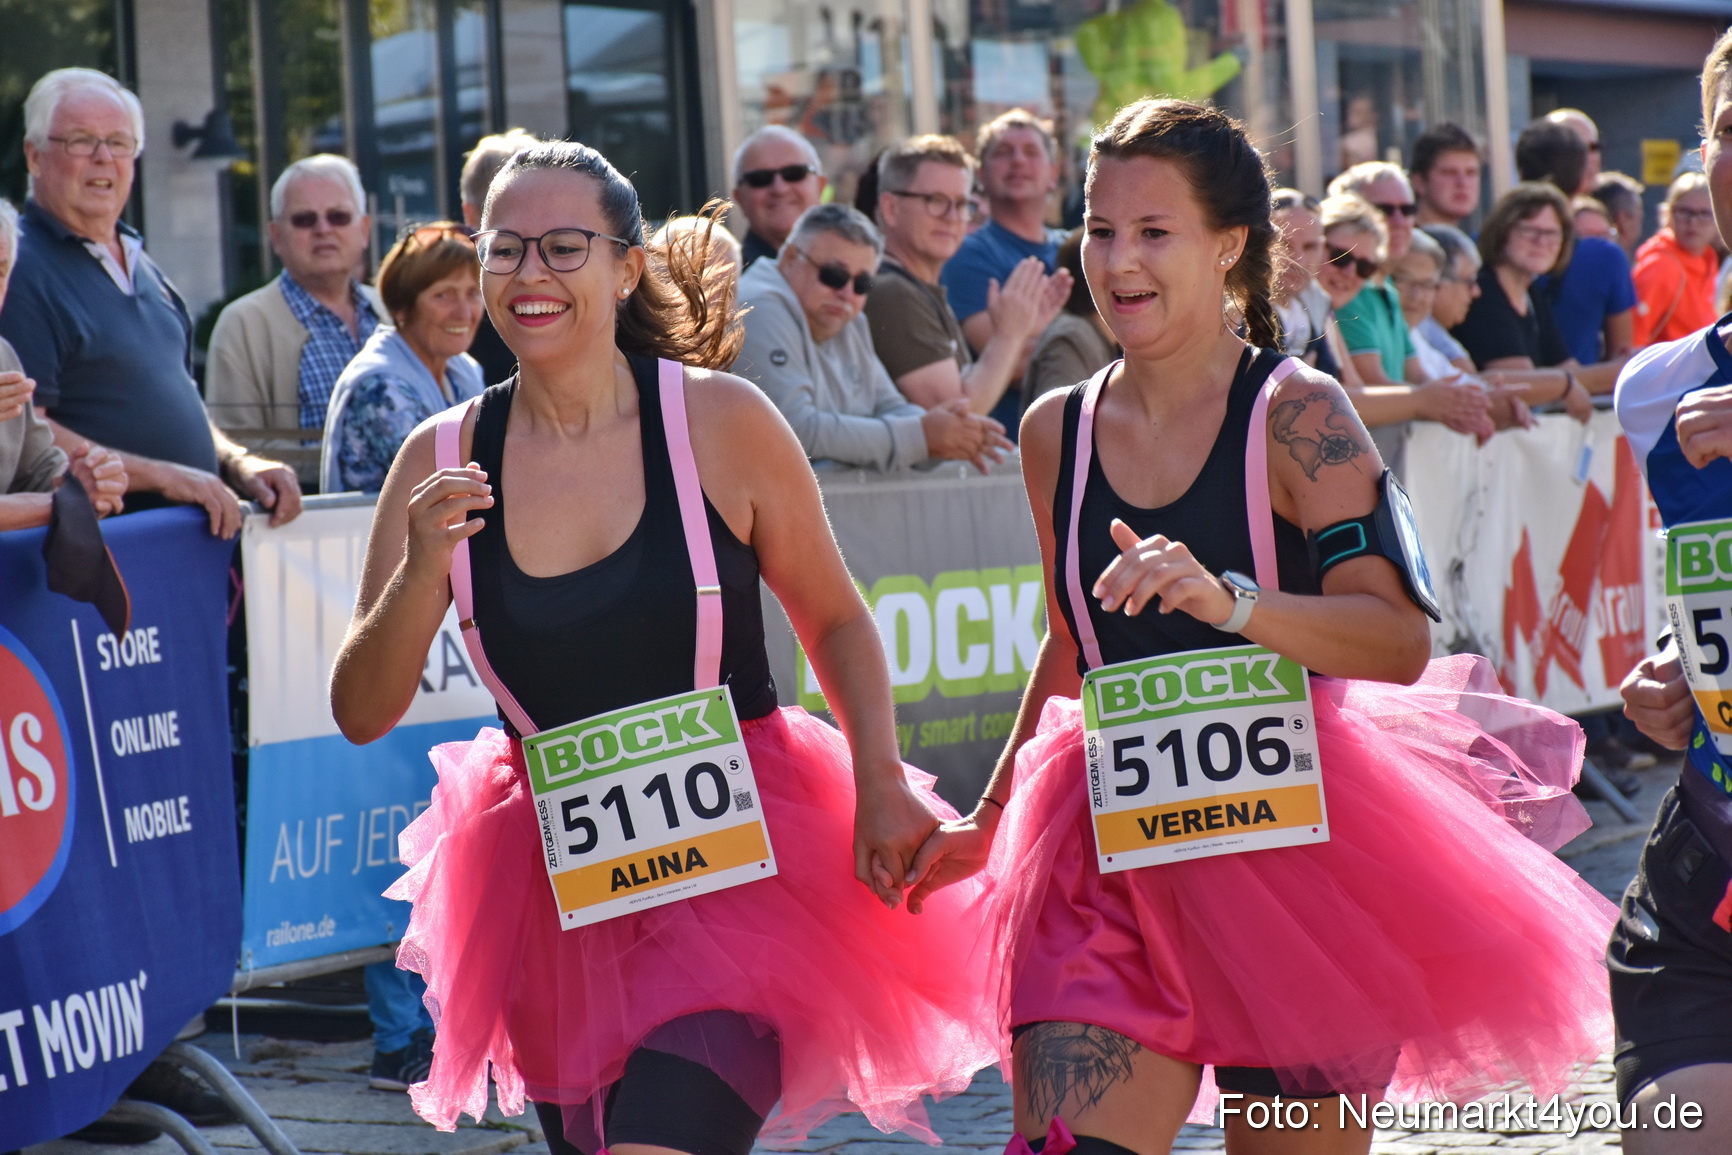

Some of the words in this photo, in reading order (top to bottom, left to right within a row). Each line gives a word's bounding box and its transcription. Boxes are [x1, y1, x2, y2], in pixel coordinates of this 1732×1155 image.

[97, 626, 161, 671] STORE
[803, 580, 1042, 694] OCK
[1693, 607, 1732, 675] 5
[1098, 656, 1283, 718] BOCK
[111, 710, 181, 757] ONLINE
[540, 701, 715, 781] BOCK
[919, 710, 976, 748] smart
[1113, 717, 1291, 797] 5106
[124, 796, 192, 843] MOBILE
[560, 761, 731, 855] 5110
[1137, 799, 1277, 841] VERENA
[269, 814, 344, 883] AUF
[610, 846, 708, 893] ALINA
[266, 914, 336, 947] railone.de
